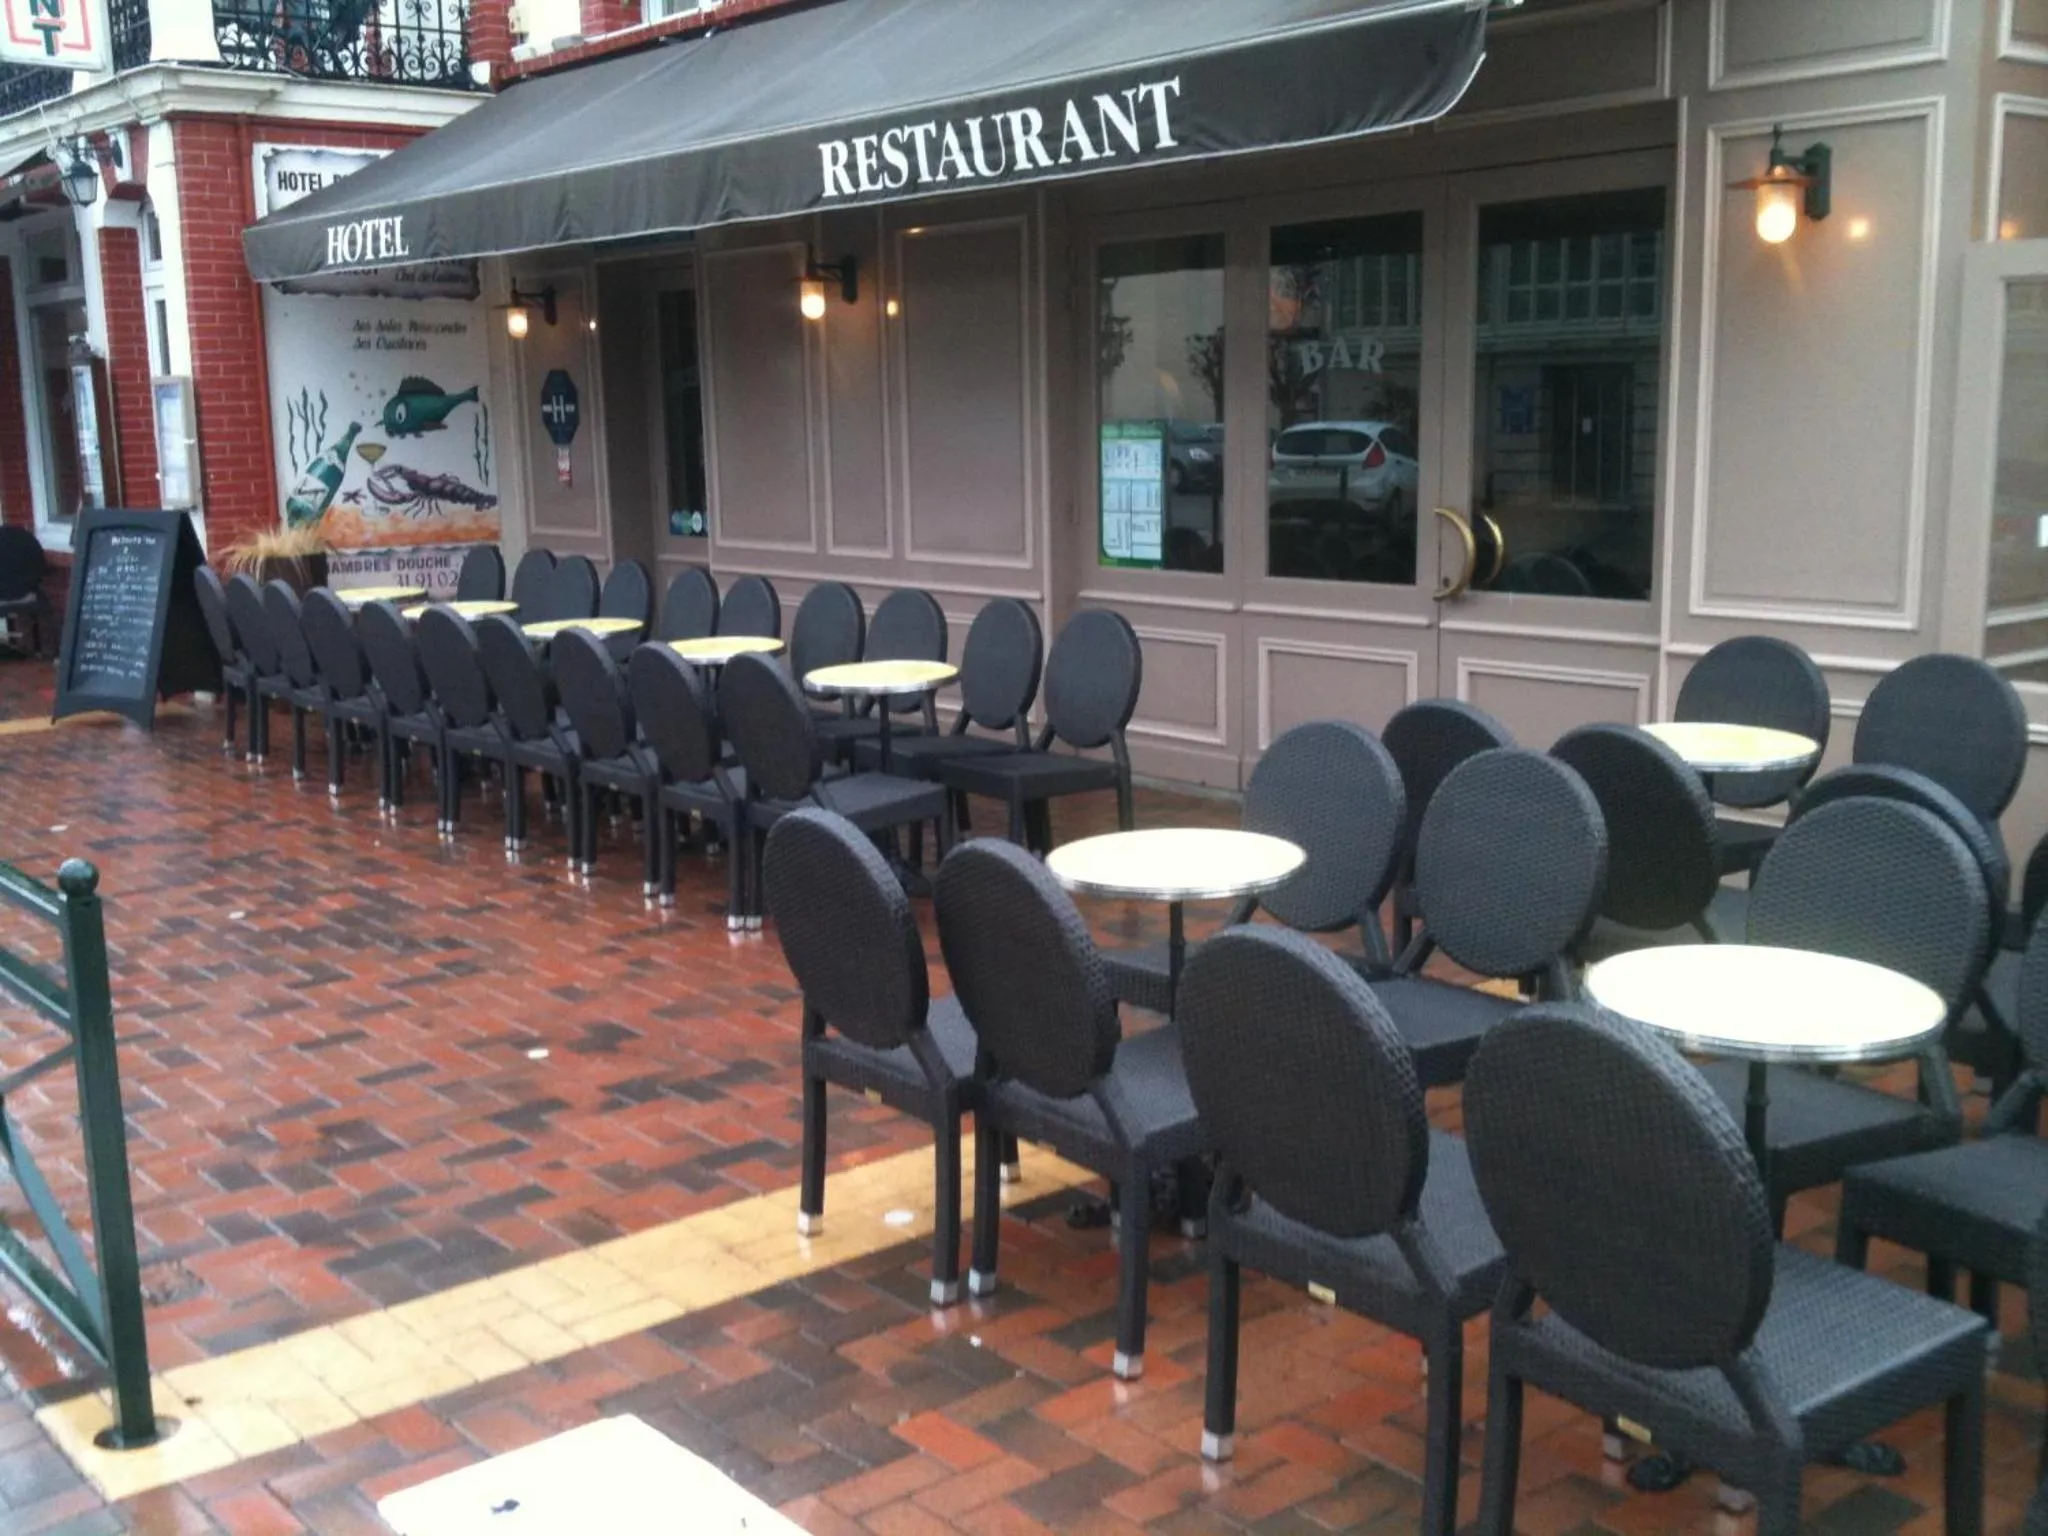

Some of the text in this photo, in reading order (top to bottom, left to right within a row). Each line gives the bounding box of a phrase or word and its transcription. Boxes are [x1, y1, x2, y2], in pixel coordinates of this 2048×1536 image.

[817, 75, 1181, 199] RESTAURANT
[278, 171, 322, 192] HOTEL
[326, 215, 409, 266] HOTEL
[1299, 336, 1385, 375] BAR
[328, 556, 391, 575] AMBRES
